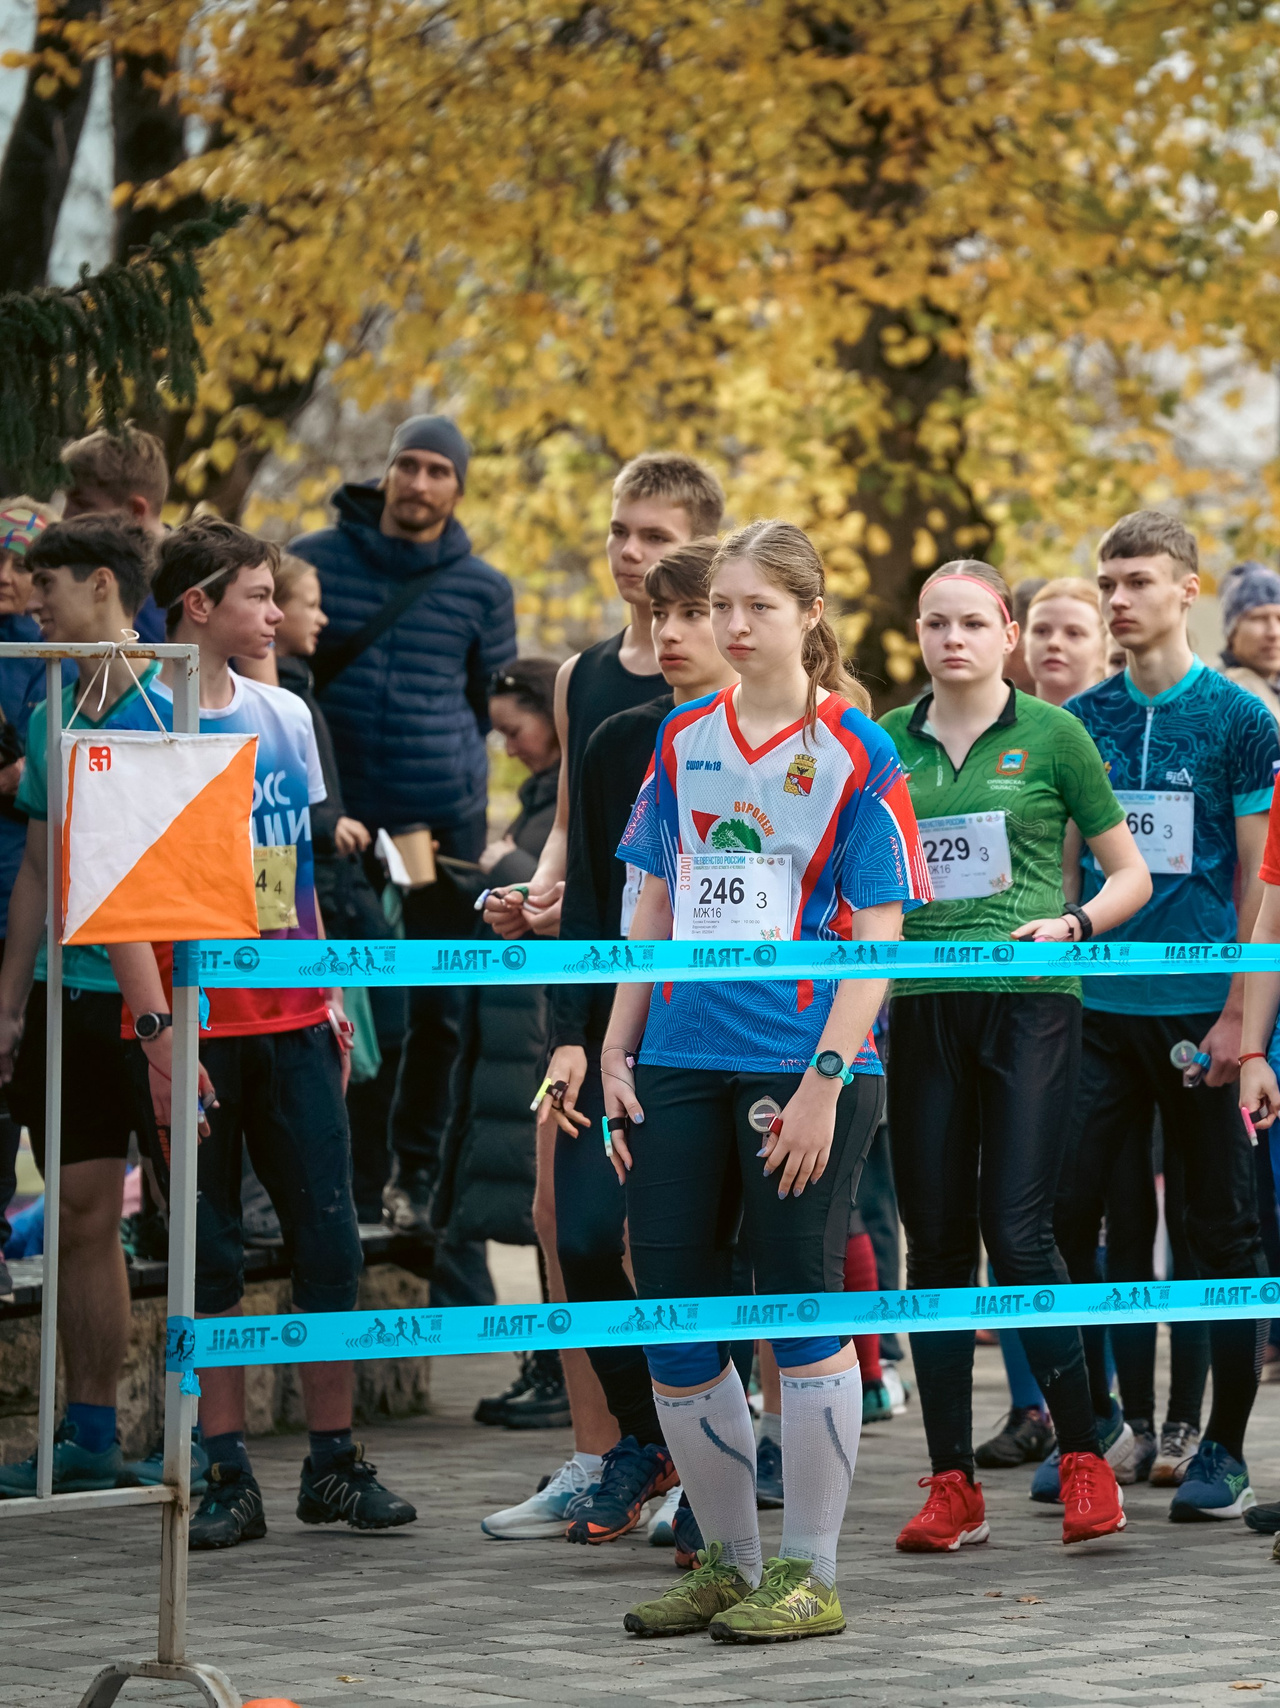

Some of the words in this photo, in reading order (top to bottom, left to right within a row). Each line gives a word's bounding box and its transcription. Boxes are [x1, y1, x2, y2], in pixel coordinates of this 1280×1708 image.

[685, 760, 704, 771] СШОР
[1163, 824, 1173, 840] 3
[922, 837, 970, 863] 229
[979, 846, 990, 862] 3
[693, 855, 723, 866] ПЕРВЕНСТВО
[723, 854, 746, 865] РОССИИ
[274, 880, 283, 895] 4
[698, 876, 745, 905] 246
[756, 891, 768, 909] 3
[692, 907, 722, 919] МЖ16
